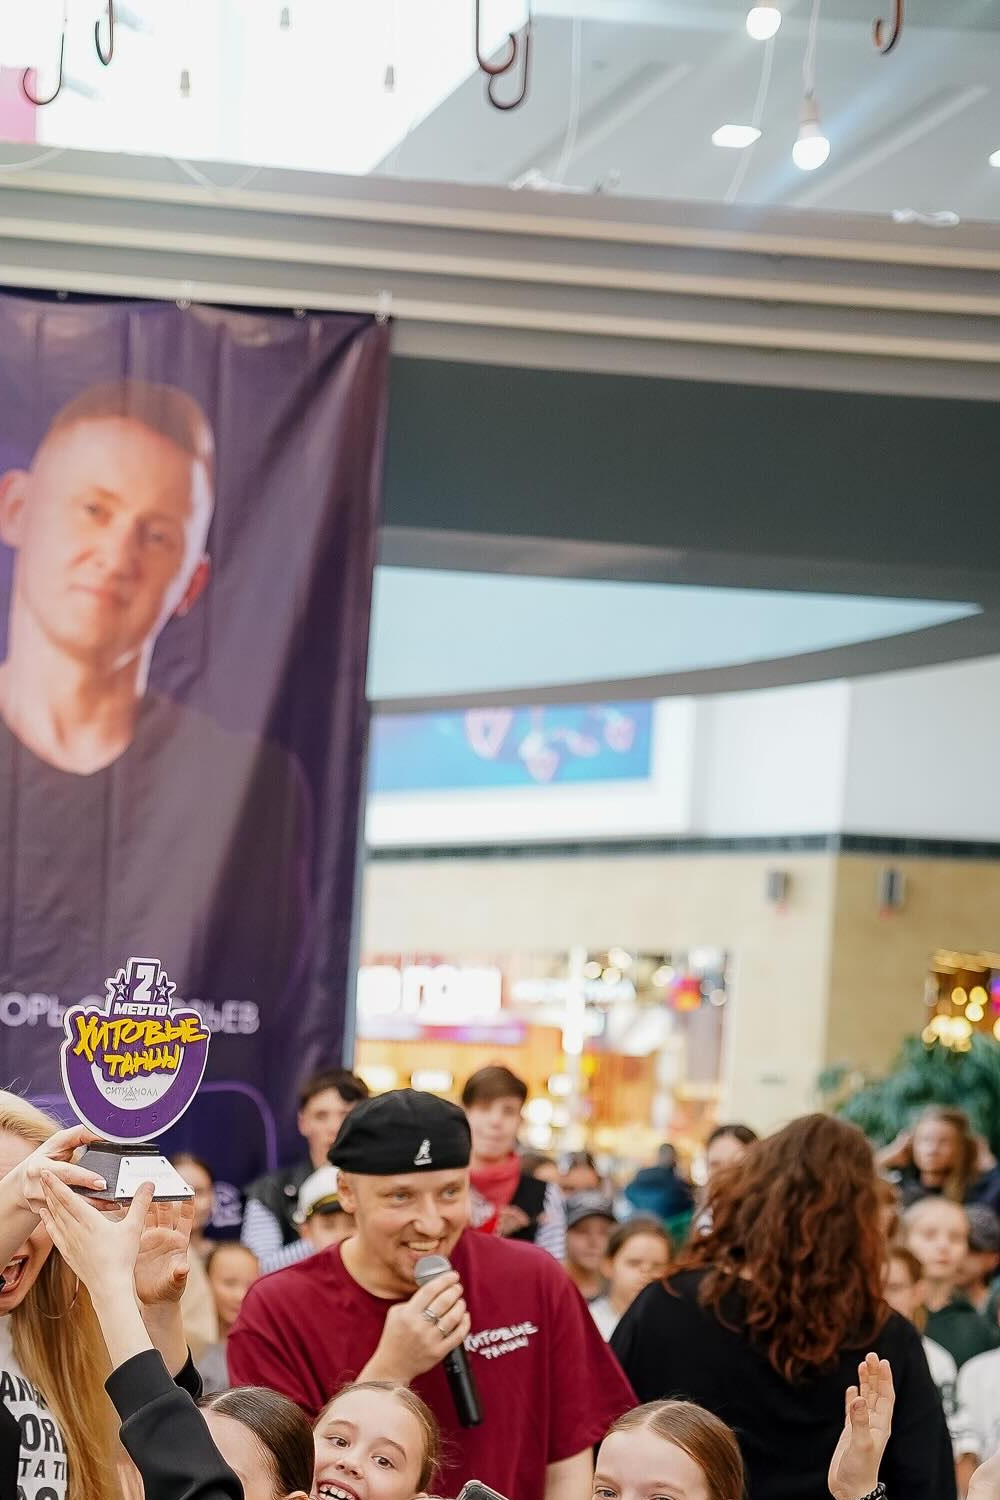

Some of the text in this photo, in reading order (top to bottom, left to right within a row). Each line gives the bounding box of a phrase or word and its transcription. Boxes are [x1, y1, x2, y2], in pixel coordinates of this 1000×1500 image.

[133, 965, 155, 1001] 2
[114, 1003, 168, 1016] МЕСТО
[73, 1015, 208, 1062] ХИТОВЫЕ
[104, 1045, 180, 1078] ТАНЦЫ
